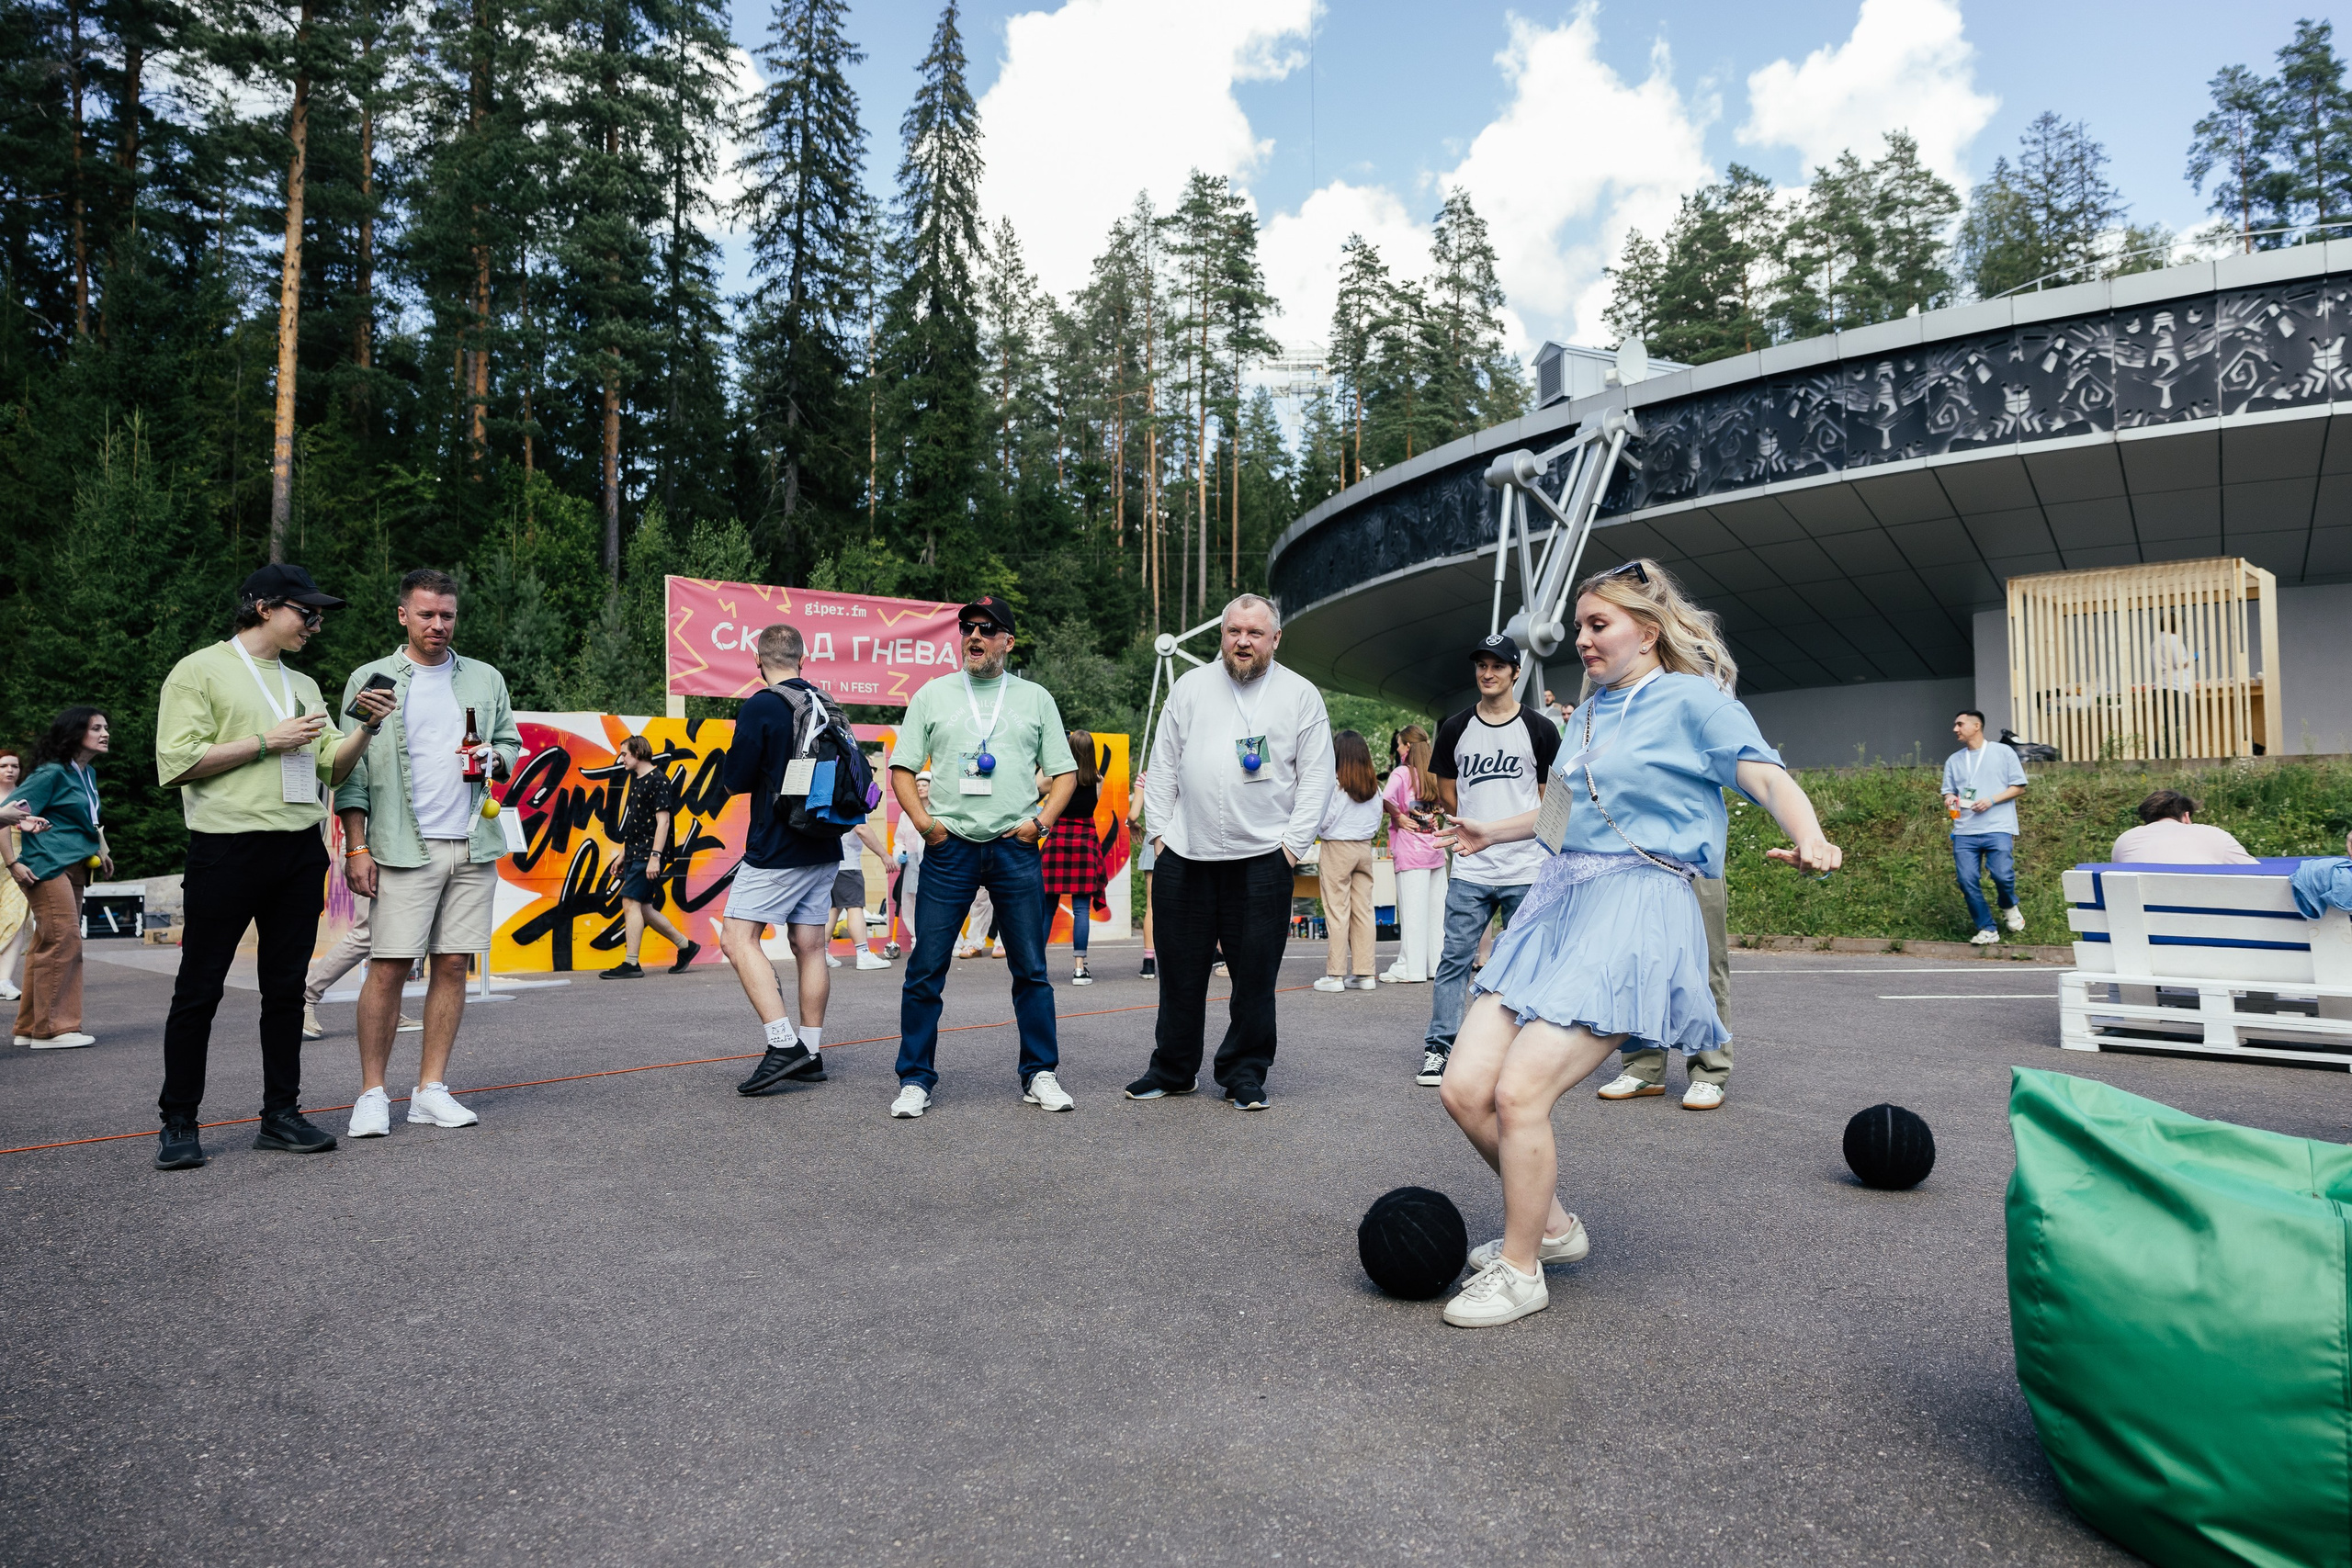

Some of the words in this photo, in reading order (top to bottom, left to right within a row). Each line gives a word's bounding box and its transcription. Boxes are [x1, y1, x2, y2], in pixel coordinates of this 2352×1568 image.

[805, 601, 867, 617] giper.fm
[711, 621, 836, 662] СКД
[852, 636, 958, 670] ГНЕВА
[851, 682, 879, 694] FEST
[946, 706, 967, 728] TOM
